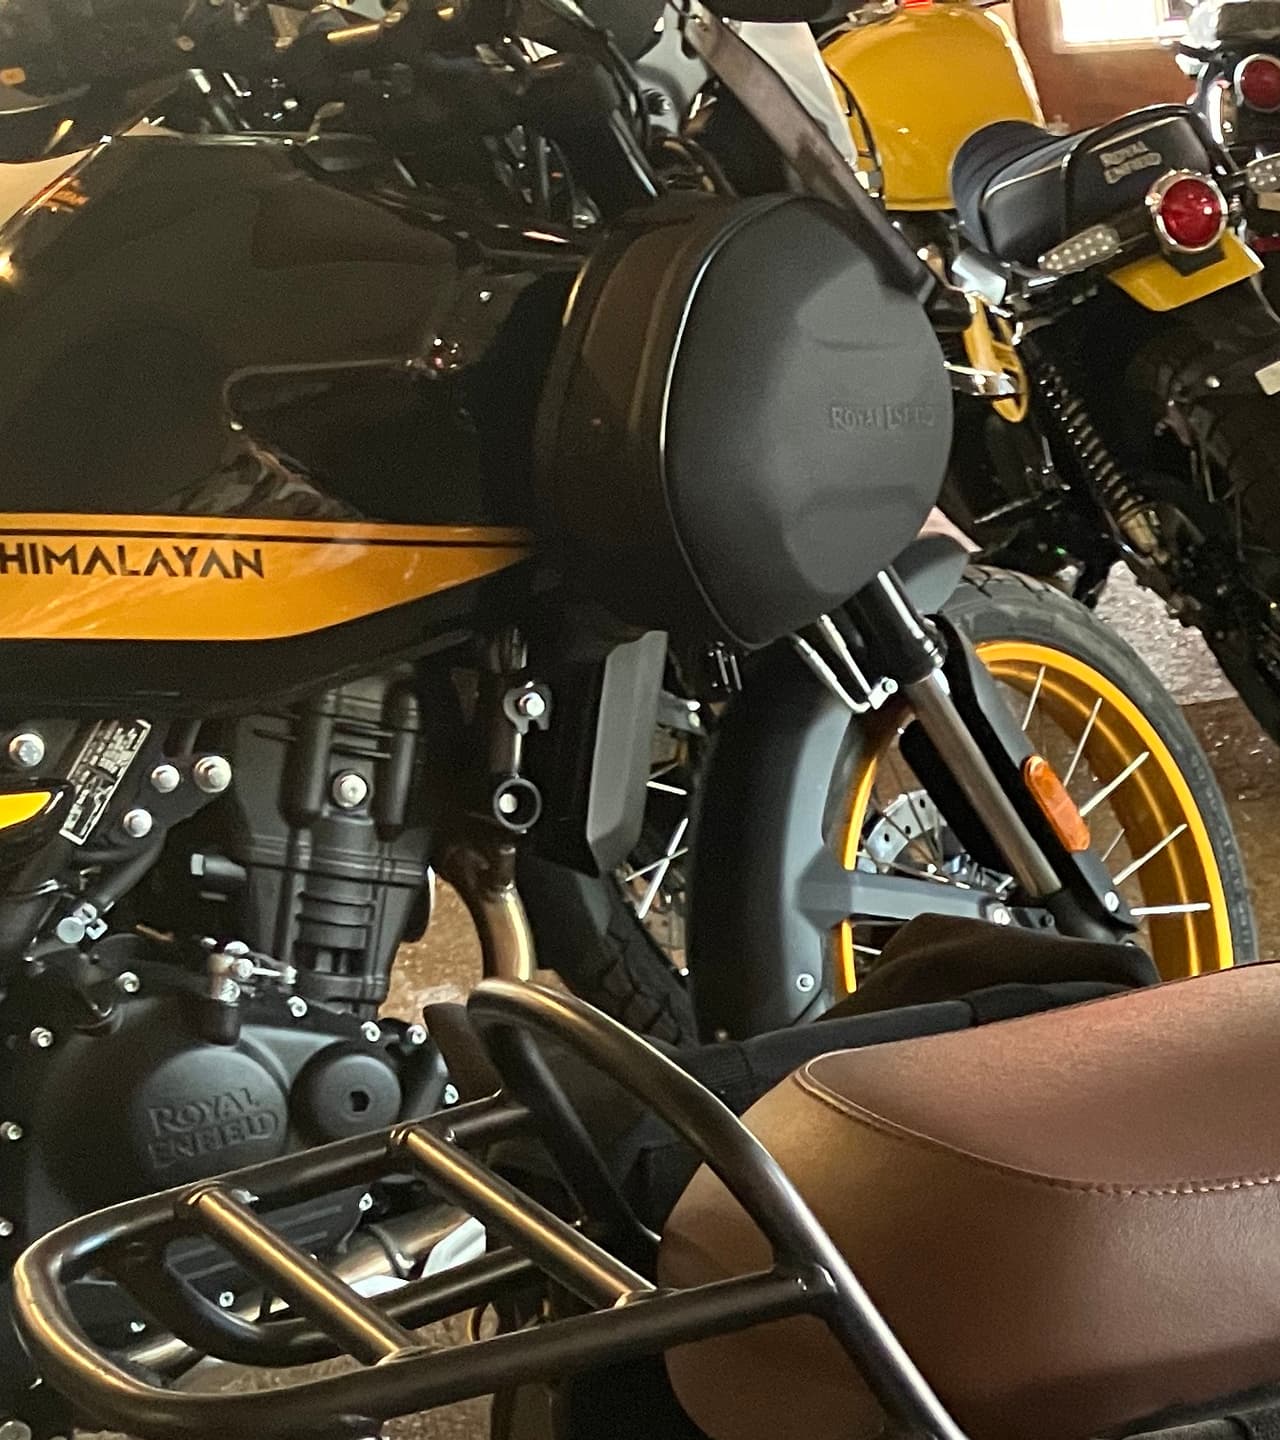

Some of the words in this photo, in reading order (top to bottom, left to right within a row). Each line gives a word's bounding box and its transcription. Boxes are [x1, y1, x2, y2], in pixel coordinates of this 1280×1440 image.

[0, 542, 265, 579] HIMALAYAN
[149, 1087, 260, 1138] ROYAL
[148, 1110, 280, 1169] ENFIELD
